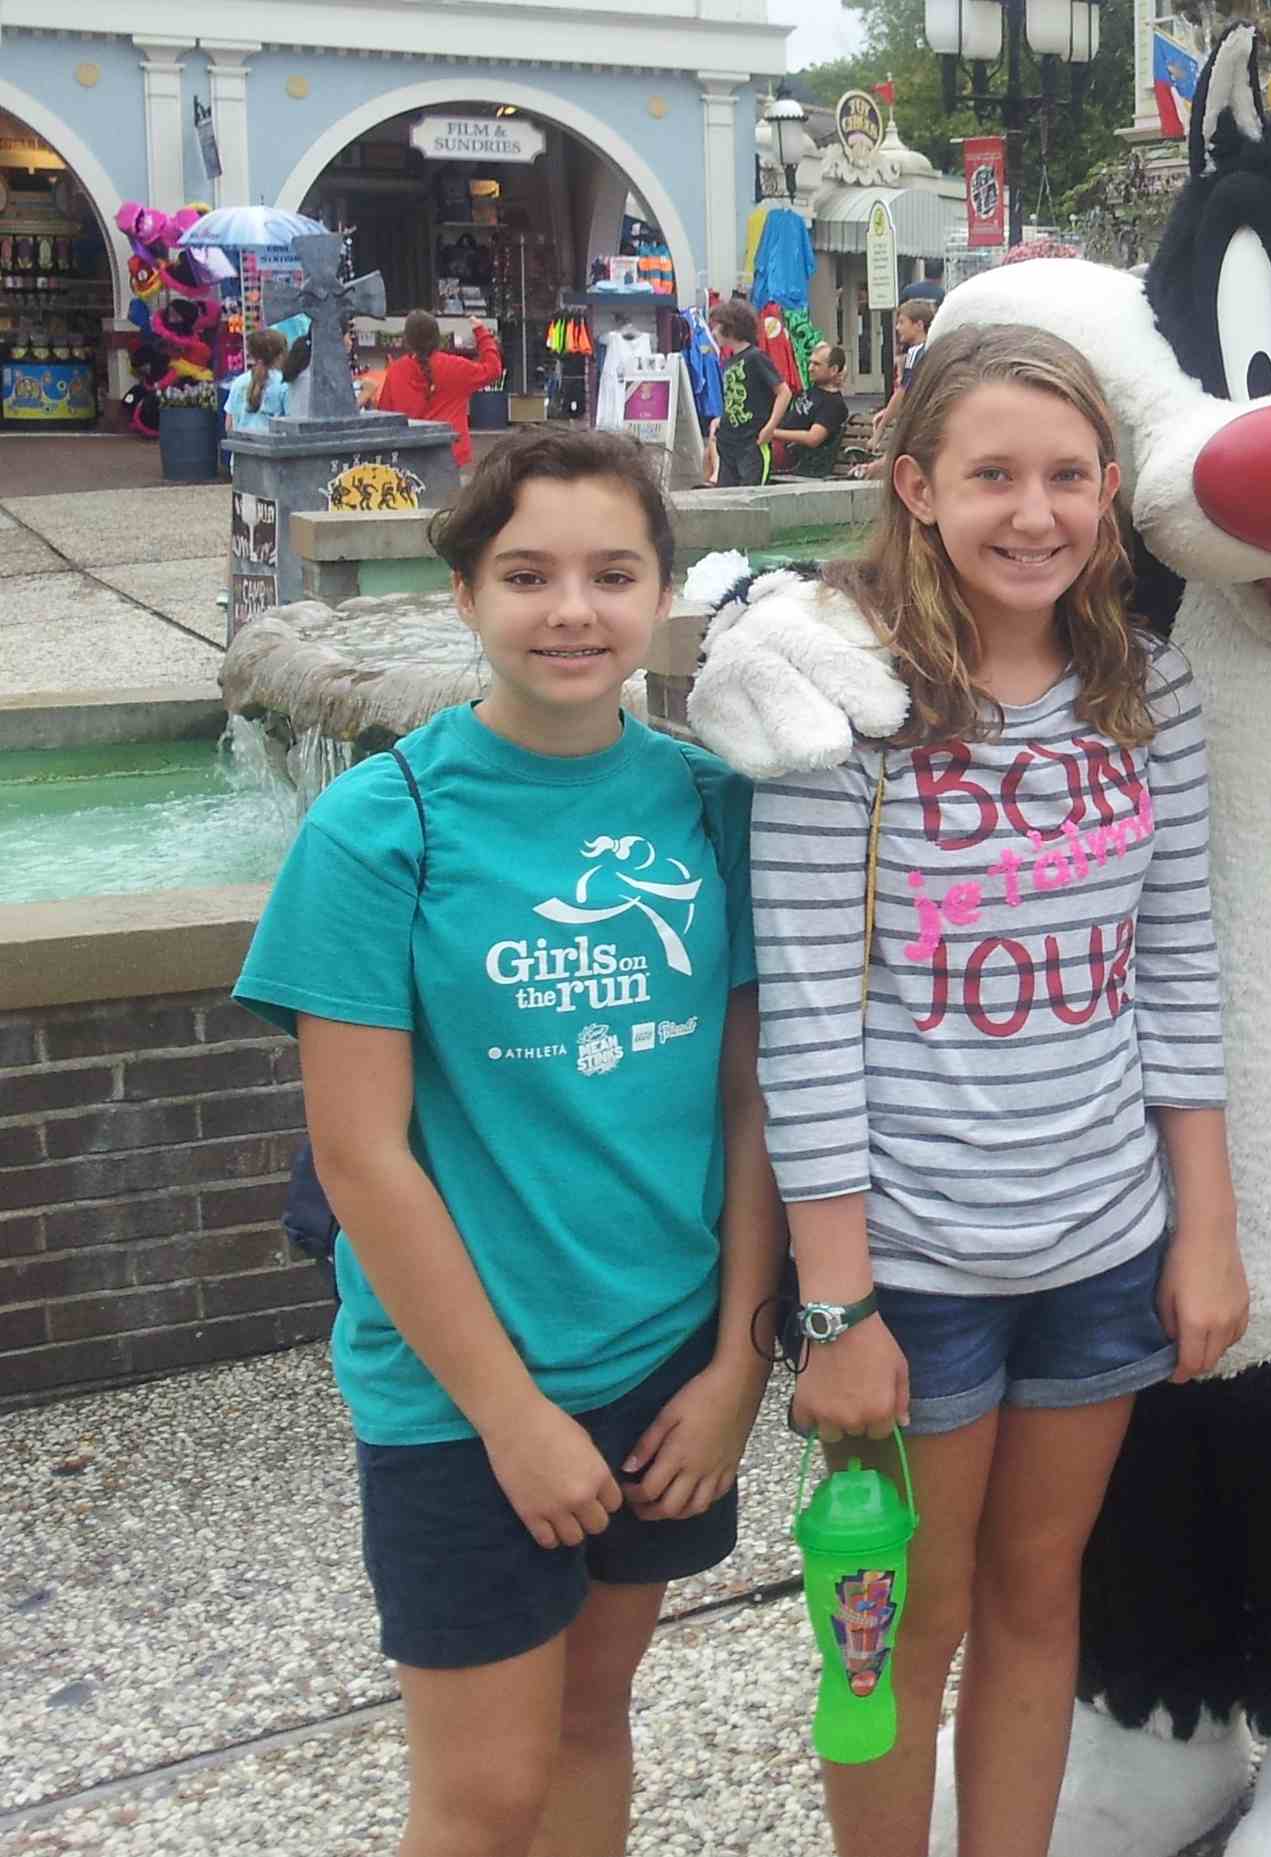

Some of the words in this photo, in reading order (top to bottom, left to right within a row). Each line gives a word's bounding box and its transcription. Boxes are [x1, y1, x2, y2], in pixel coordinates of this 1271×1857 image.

[433, 136, 522, 153] SUNDRIES
[447, 122, 489, 136] FILM
[494, 124, 507, 138] &
[911, 736, 1145, 851] BON
[904, 868, 983, 962] je
[485, 935, 618, 985] Girls
[618, 955, 649, 972] on
[912, 915, 1134, 1038] JOUR
[515, 986, 557, 1009] the
[556, 970, 651, 1013] run
[505, 1043, 569, 1060] ATHLETA
